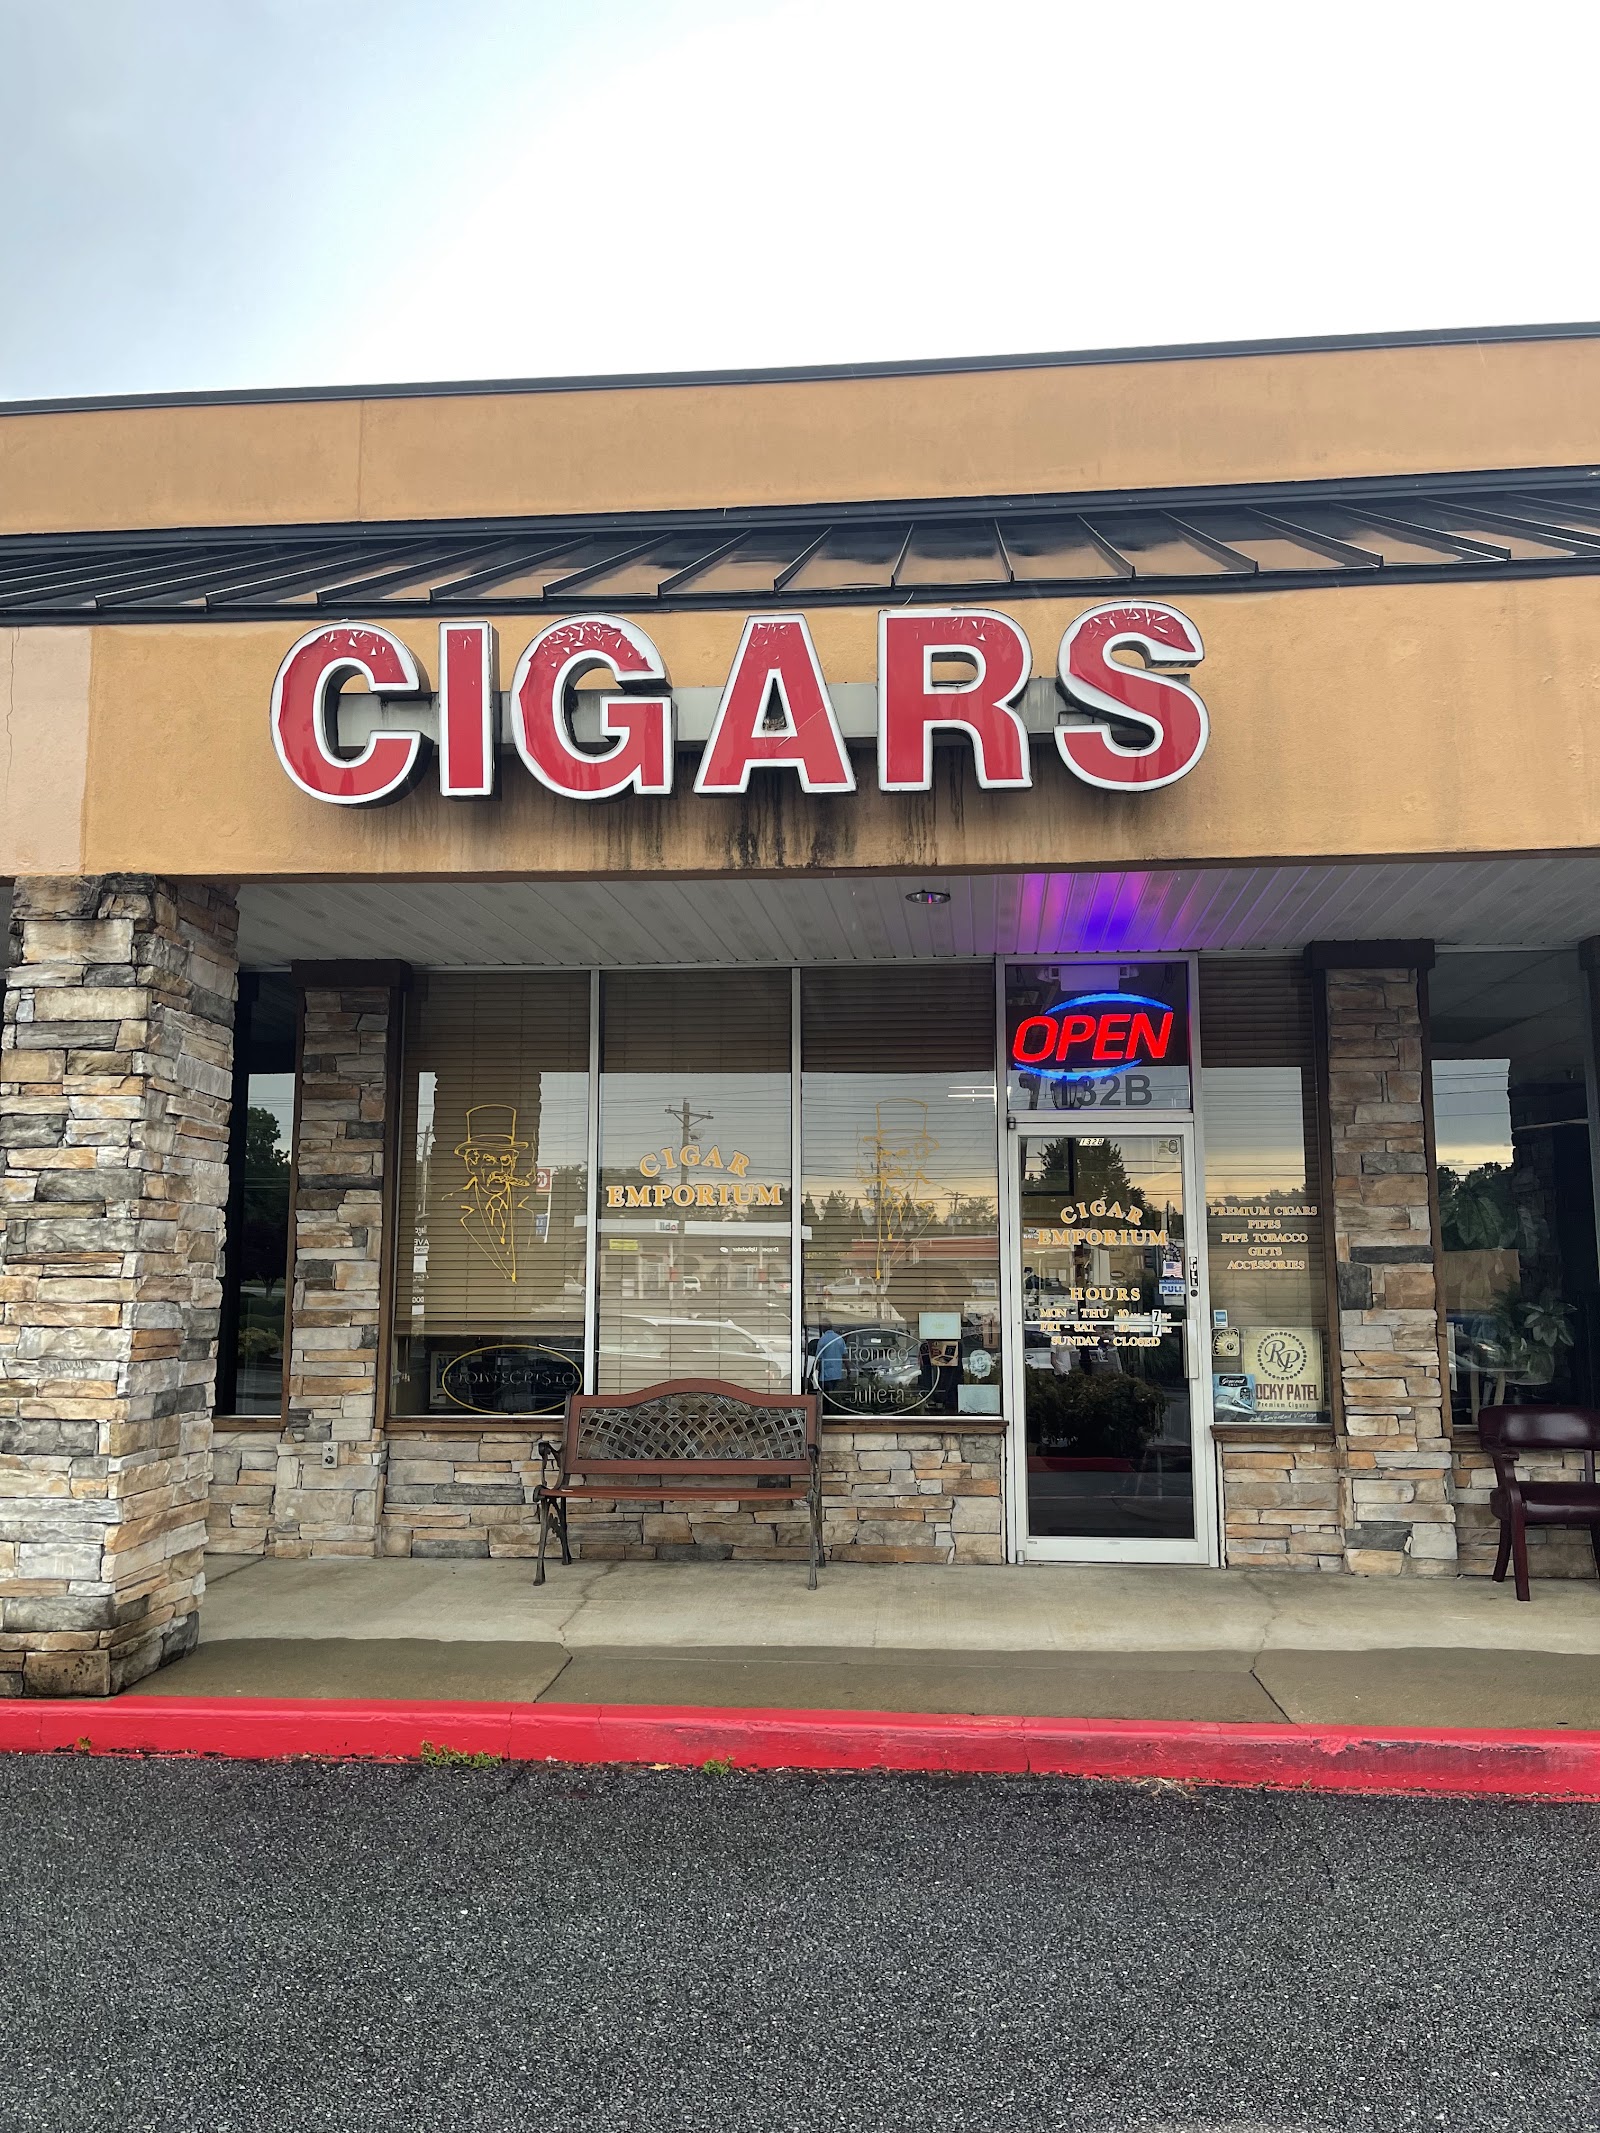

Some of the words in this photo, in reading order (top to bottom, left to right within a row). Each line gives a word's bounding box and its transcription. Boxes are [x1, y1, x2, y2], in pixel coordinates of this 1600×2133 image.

[270, 602, 1210, 805] CIGARS
[1012, 1012, 1174, 1063] OPEN
[639, 1145, 750, 1178] CIGAR
[606, 1184, 783, 1207] EMPORIUM
[1060, 1200, 1143, 1226] CIGAR
[1210, 1206, 1270, 1216] PREMIUM
[1274, 1206, 1318, 1216] CIGARS
[1248, 1219, 1281, 1229] PIPES
[1038, 1229, 1168, 1246] EMPORIUM
[1221, 1233, 1248, 1243] PIPE
[1253, 1233, 1308, 1243] TOBACCO
[1248, 1247, 1282, 1256] GIFTS
[1190, 1257, 1199, 1286] PULL
[1227, 1260, 1305, 1270] ACCESSORIES
[1069, 1287, 1140, 1301] HOURS
[1039, 1308, 1067, 1318] MON
[1080, 1308, 1109, 1318] THU
[1039, 1323, 1061, 1332] FRI
[1074, 1323, 1096, 1332] SAT
[1051, 1336, 1100, 1346] SUNDAY
[1113, 1336, 1160, 1347] CLOSED
[1255, 1384, 1284, 1400] OCKY
[1287, 1384, 1319, 1401] PATEL
